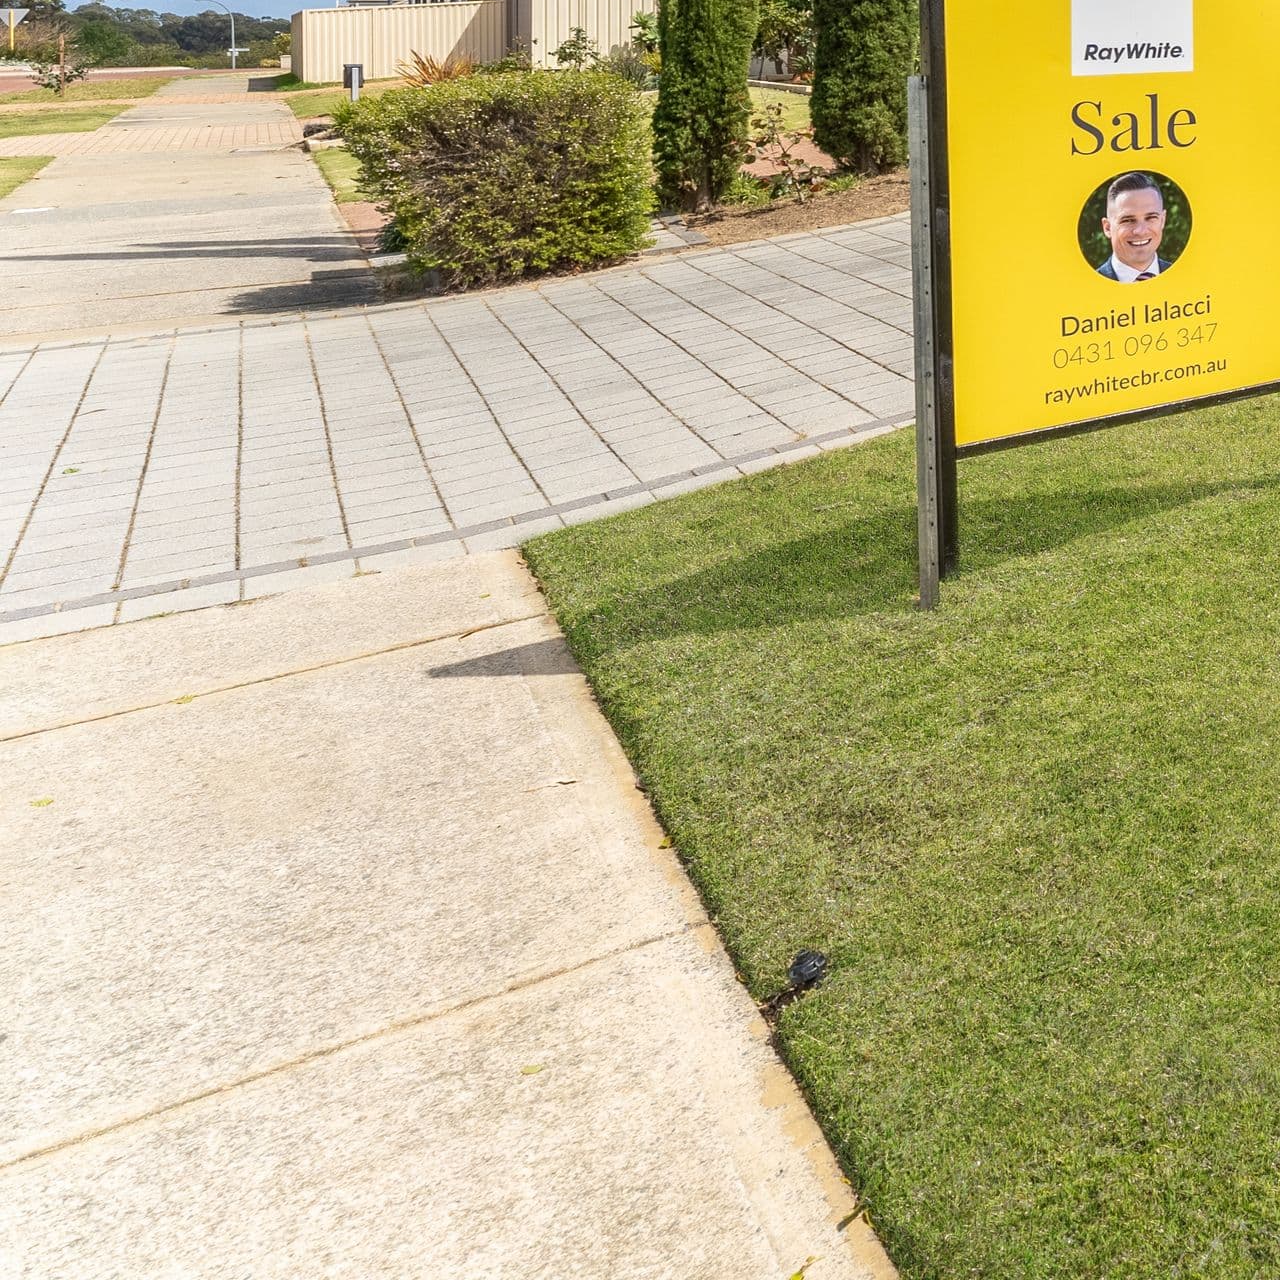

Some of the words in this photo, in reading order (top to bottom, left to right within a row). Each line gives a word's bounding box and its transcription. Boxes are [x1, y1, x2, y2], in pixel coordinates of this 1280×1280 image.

[1070, 93, 1197, 156] Sale
[1061, 305, 1136, 337] Daniel
[1144, 294, 1211, 324] Ialacci
[1053, 340, 1115, 369] 0431
[1124, 332, 1169, 357] 096
[1176, 322, 1218, 348] 347
[1045, 358, 1227, 404] raywhitecbr.com.au
